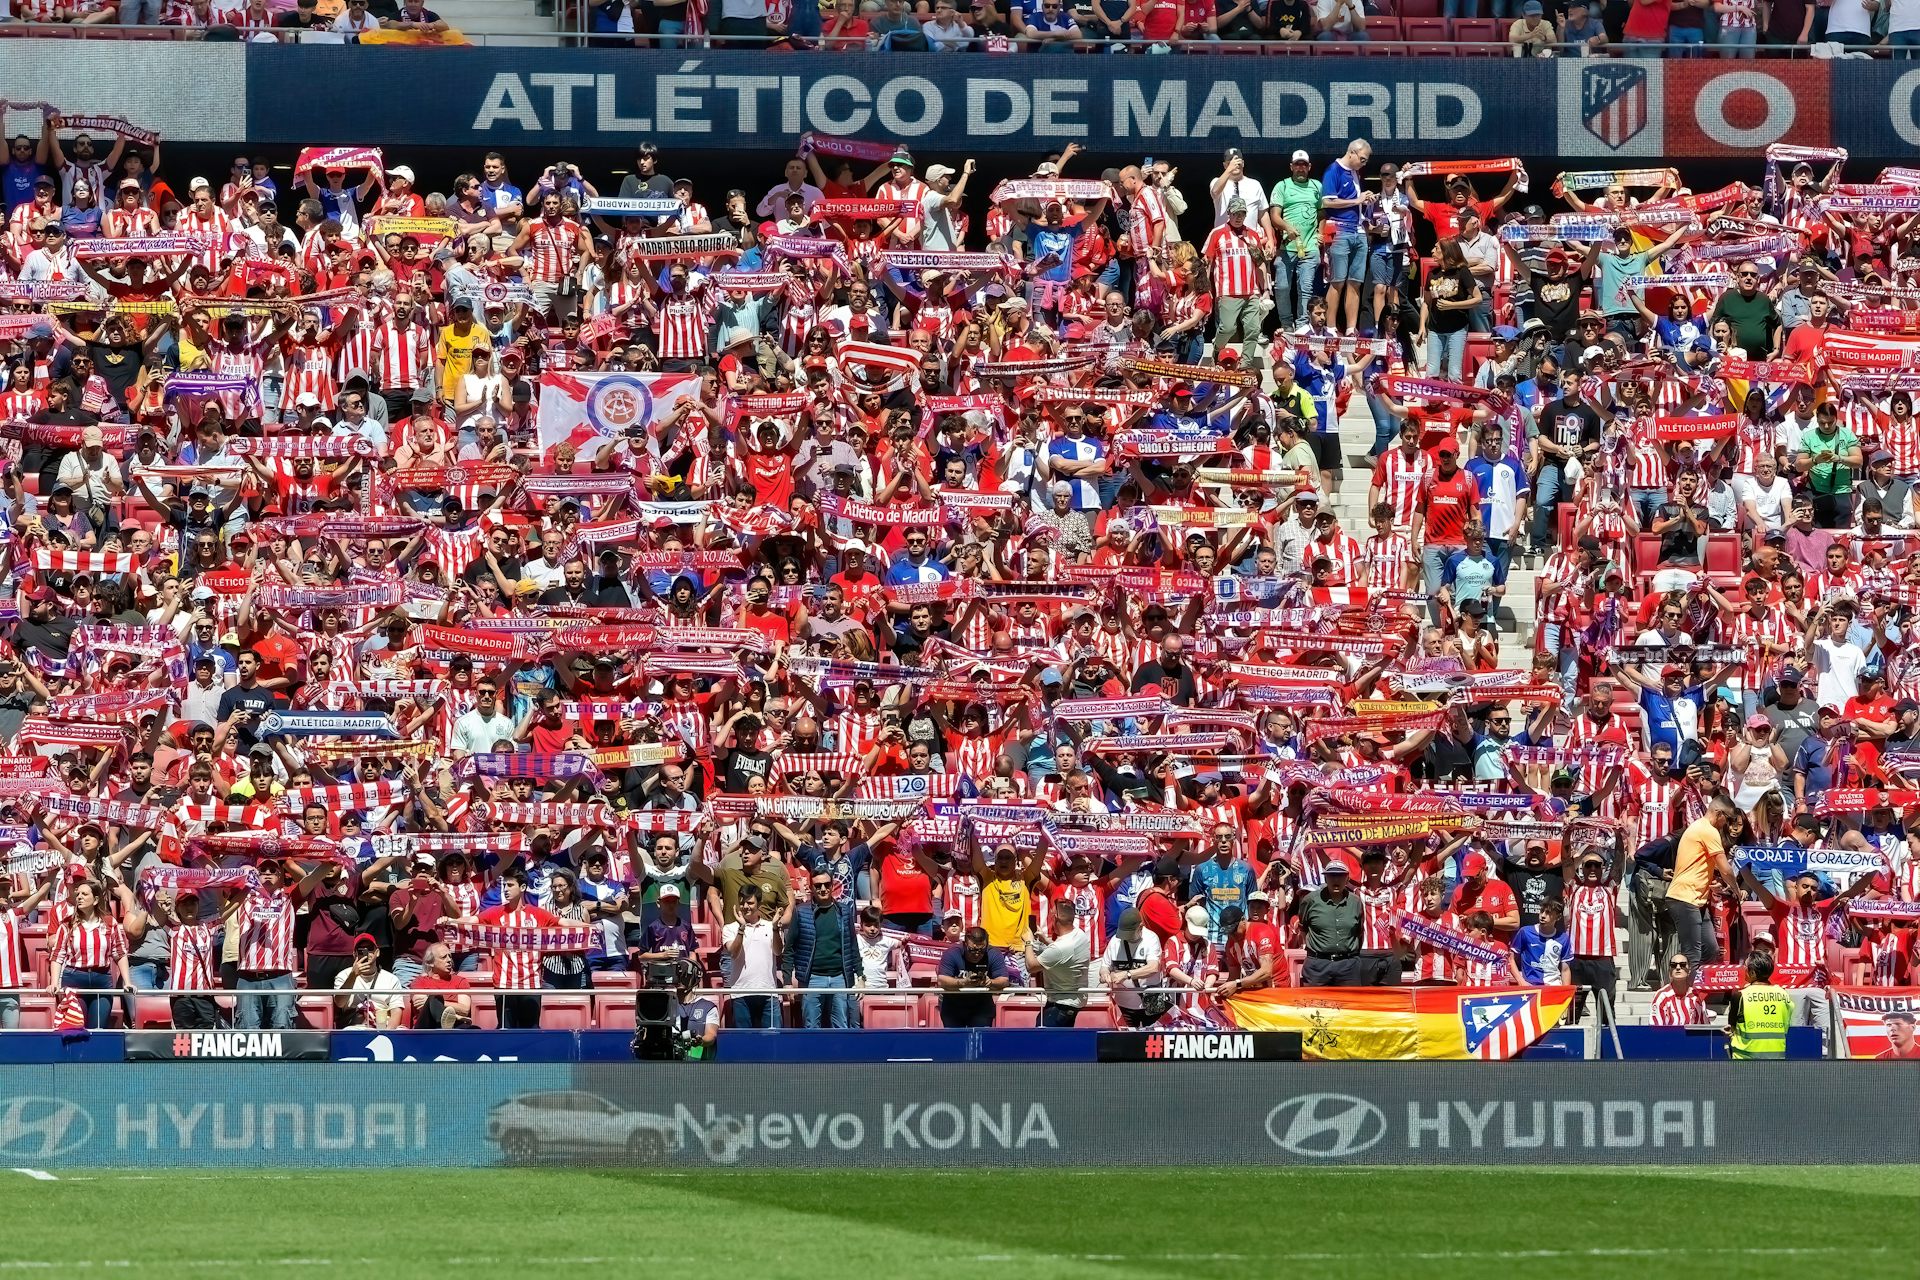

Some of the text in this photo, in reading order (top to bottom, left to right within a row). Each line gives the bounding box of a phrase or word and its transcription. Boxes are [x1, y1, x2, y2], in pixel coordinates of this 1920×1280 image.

[472, 60, 1483, 140] ATLÉTICO DE MADRID
[816, 140, 853, 153] CHOLO
[1477, 160, 1510, 169] Madrid
[1055, 183, 1065, 191] DE
[1068, 182, 1104, 192] MADRID
[1699, 186, 1738, 204] ATLETICO
[597, 201, 677, 211] ATLÉTICO MADRID
[1862, 195, 1920, 209] MADRID
[814, 203, 895, 214] ATLÉTICO MADRID
[1638, 211, 1681, 225] ATLETI
[1707, 219, 1745, 235] ULTRAS
[123, 242, 136, 253] de
[138, 239, 176, 251] Madrid
[638, 242, 670, 254] MADRID
[673, 240, 697, 253] SOLO
[887, 252, 939, 265] ATLÉTICO
[1660, 275, 1729, 284] HASTA VENCER
[33, 286, 62, 297] Madrid
[1854, 316, 1900, 325] ATLETICO
[1867, 353, 1900, 361] MADRID
[175, 372, 208, 380] ATLÉTICO
[218, 373, 245, 381] MADRID
[1393, 381, 1480, 398] CAMPEONES
[1045, 388, 1153, 405] FONDO SUR 1982
[748, 398, 781, 409] PARTIDO
[1658, 420, 1736, 432] ATLÉTICO MADRID
[69, 435, 79, 444] de
[1127, 434, 1156, 443] MADRID
[313, 441, 347, 450] MADRID
[1138, 441, 1216, 453] CHOLO SIMEONE
[947, 496, 970, 505] RUIZ
[843, 501, 940, 522] Atlético de Madrid
[205, 577, 245, 587] ATLÉTICO
[1118, 574, 1154, 587] MADRID
[1161, 578, 1172, 587] DE
[359, 586, 390, 604] MADRID
[616, 610, 653, 622] Madrid
[1254, 611, 1268, 623] DE
[535, 620, 552, 628] DE
[425, 631, 512, 650] ATLÉTICO MADRID
[555, 630, 594, 647] Atlético
[599, 632, 608, 642] de
[616, 630, 653, 644] Madrid
[1263, 635, 1385, 654] ATLETICO MADRID
[1292, 669, 1329, 679] MADRID
[609, 704, 627, 713] DE
[1120, 701, 1155, 712] MADRID
[1391, 703, 1401, 712] DE
[1403, 702, 1429, 712] MADRID
[290, 718, 381, 728] ATLÉTICO MADRID
[1172, 733, 1215, 745] Madrid
[606, 750, 635, 764] CORAJE
[13, 764, 31, 772] 2003
[734, 755, 767, 773] EVERLAST
[896, 777, 926, 793] 120
[1379, 799, 1440, 813] de Madrid
[1459, 795, 1525, 806] ÉTICO SIEMPRE
[555, 804, 593, 816] MADRID
[1126, 813, 1185, 830] ARAGONÉS
[1310, 821, 1423, 843] ATLETICO DE MADRID
[1748, 849, 1796, 863] CORAJE
[1798, 851, 1806, 864] Y
[252, 912, 280, 920] Plus500
[463, 930, 584, 945] ATLETICO DE MADRID
[1404, 920, 1497, 962] ATLÉTICO MADRID
[1791, 975, 1795, 983] 7
[1837, 992, 1920, 1013] RIQUEL
[1763, 1004, 1776, 1015] 92
[172, 1033, 282, 1057] #FANCAM
[1145, 1034, 1254, 1059] #FANCAM
[116, 1102, 427, 1149] HYUNDAI
[674, 1102, 1060, 1149] Nuevo KONA
[1408, 1100, 1715, 1149] HYUNDAI
